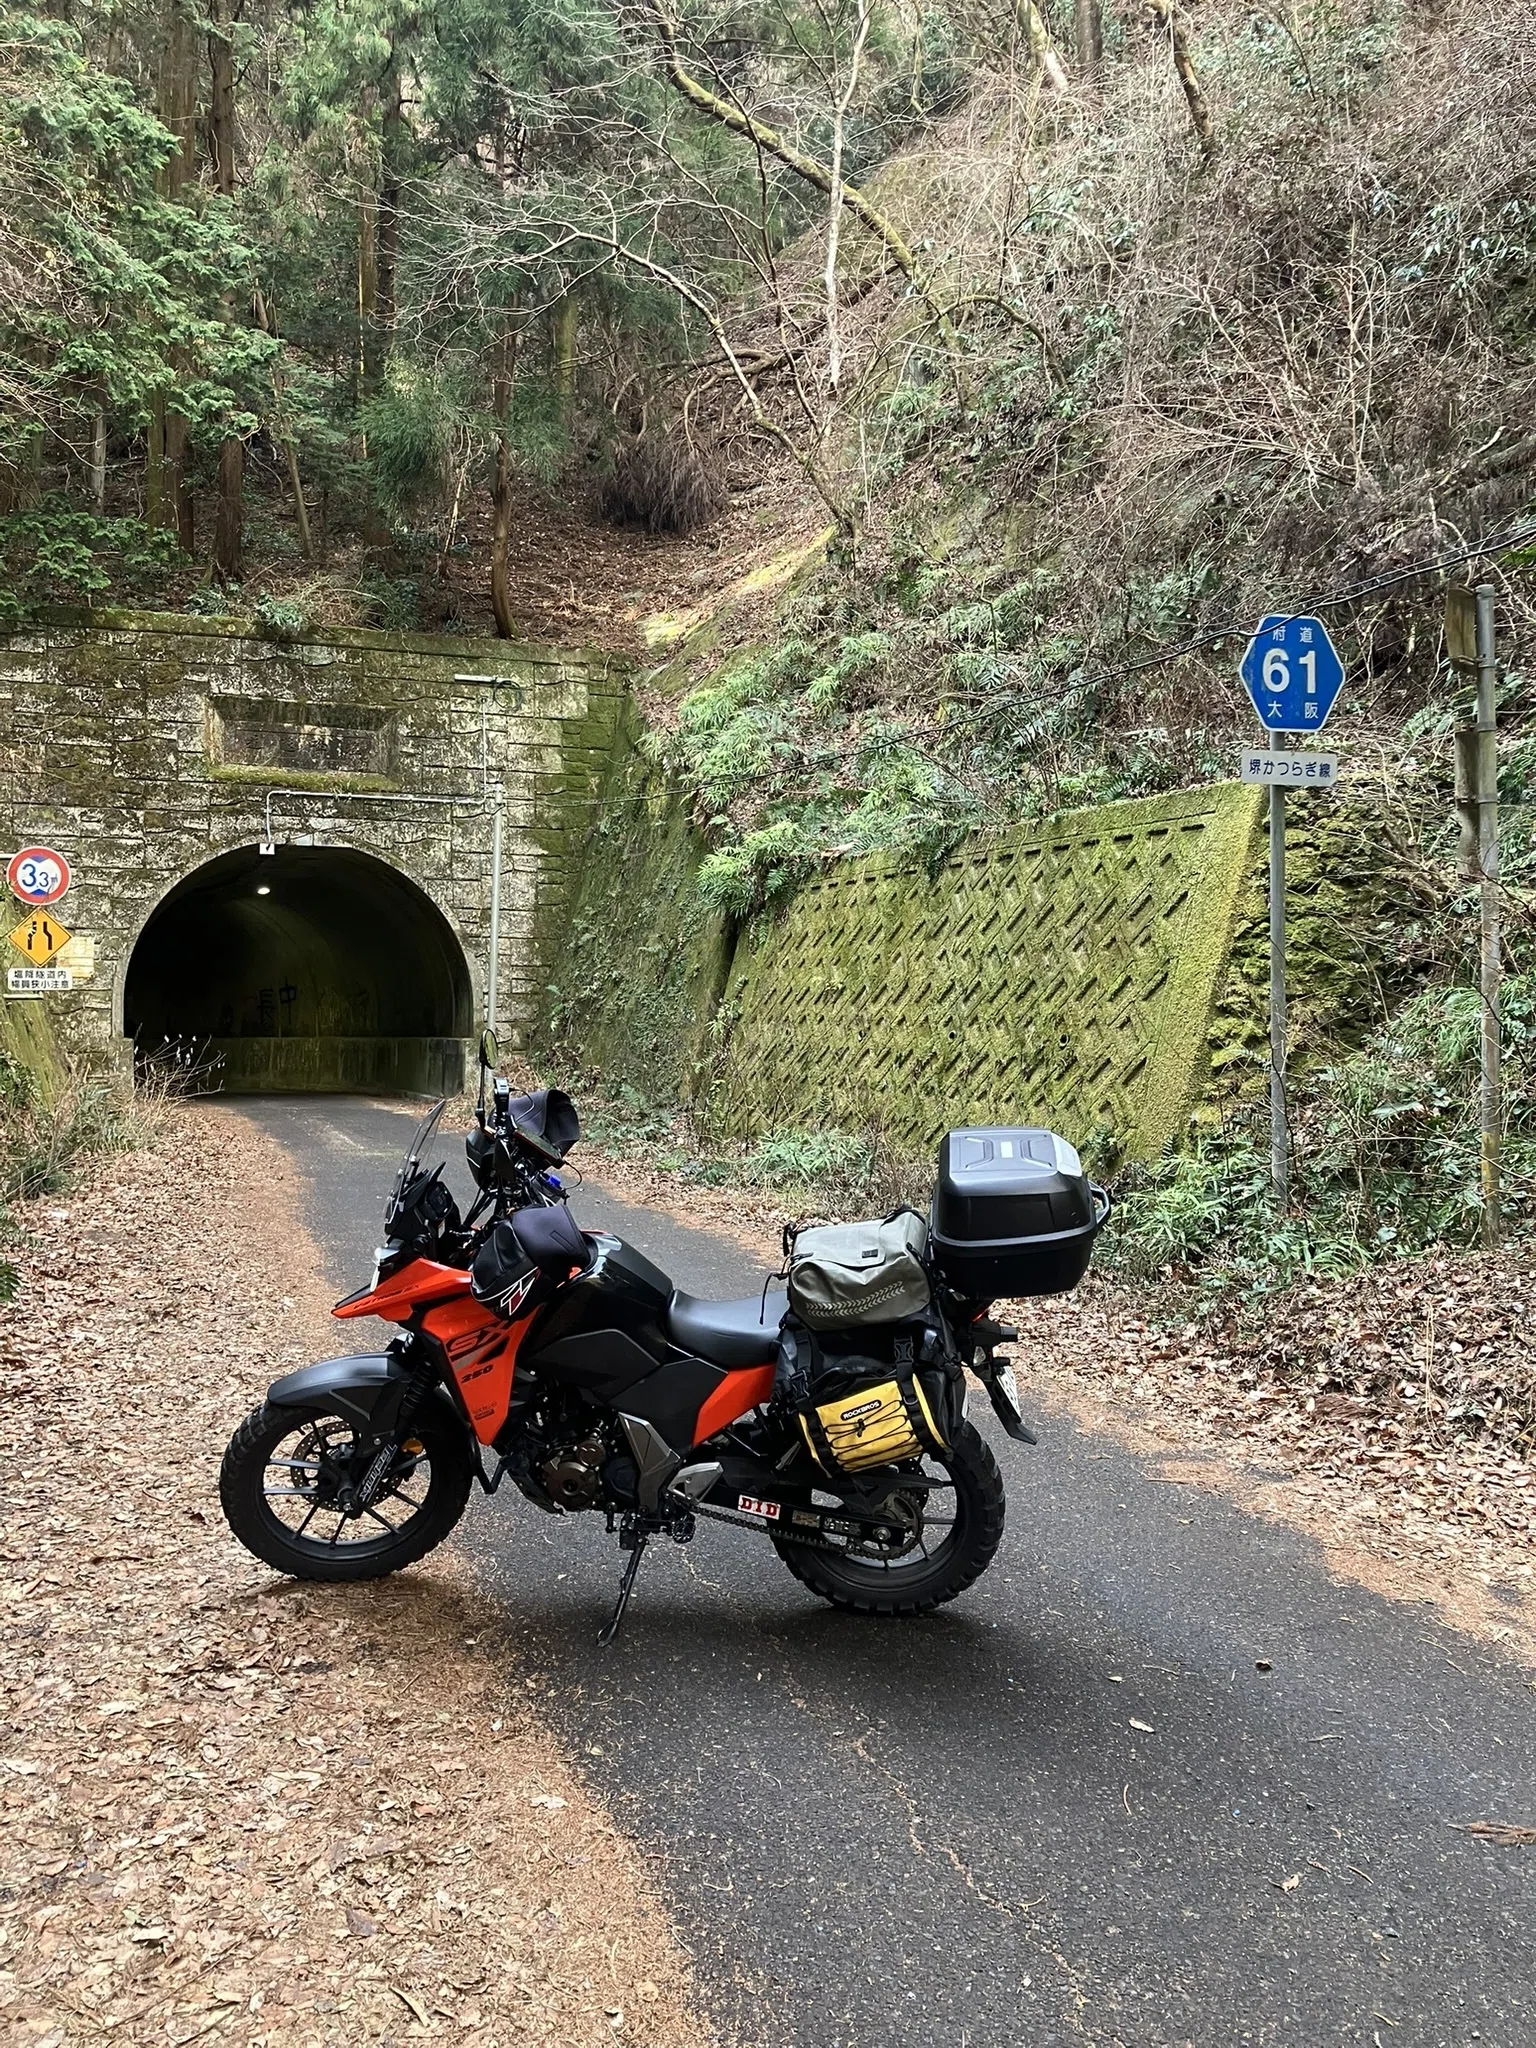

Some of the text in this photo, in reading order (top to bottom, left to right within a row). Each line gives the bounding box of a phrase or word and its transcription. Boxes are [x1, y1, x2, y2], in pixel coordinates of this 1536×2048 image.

[1272, 625, 1314, 643] 府道
[1262, 647, 1317, 694] 61
[1267, 700, 1319, 719] 大阪
[1249, 758, 1332, 779] 堺かつらぎ線
[11, 979, 69, 989] 幅員狭小注意
[461, 1364, 494, 1384] 250
[842, 1400, 881, 1420] ROCKBROS
